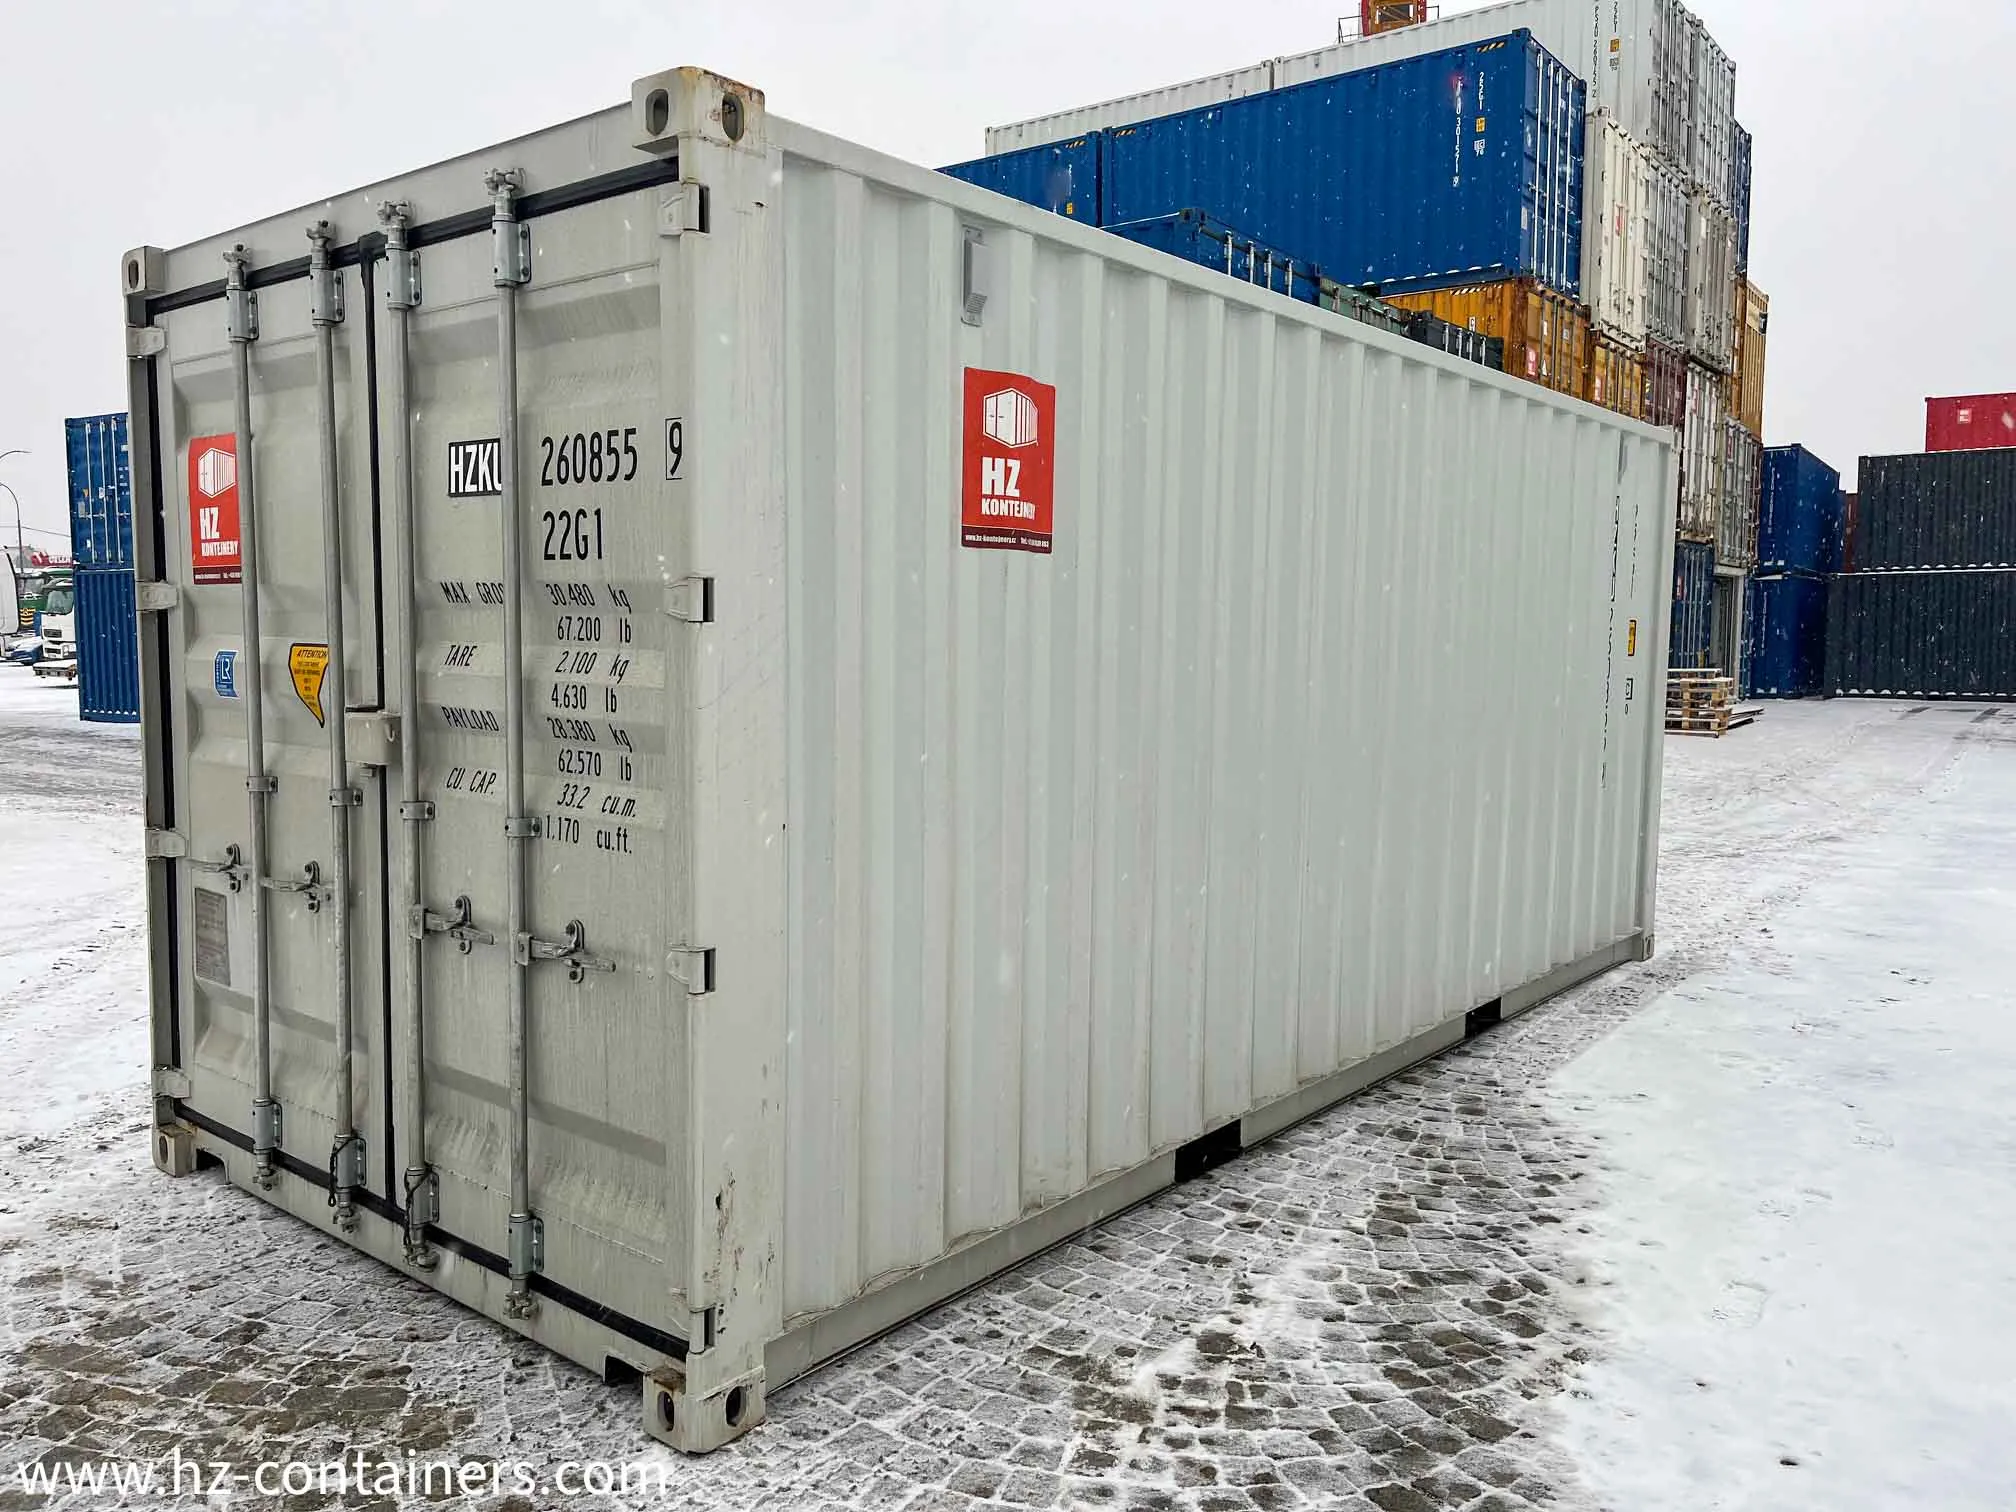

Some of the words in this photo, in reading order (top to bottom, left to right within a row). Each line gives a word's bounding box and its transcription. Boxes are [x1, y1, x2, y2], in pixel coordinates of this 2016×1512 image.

[541, 428, 638, 487] 260855
[669, 421, 683, 477] 9
[982, 456, 1021, 498] HZ
[199, 507, 220, 540] HZ
[543, 508, 603, 561] 22G1
[440, 582, 471, 604] MAX
[545, 583, 596, 607] 30.480
[608, 584, 632, 614] kg
[557, 616, 601, 642] 67.200
[619, 617, 632, 643] lb
[444, 645, 478, 667] TARE
[555, 651, 598, 675] 2.100
[609, 654, 630, 684] kg
[551, 683, 587, 710] 4.630
[605, 687, 617, 713] lb
[441, 706, 500, 732] PAYLOAD
[547, 717, 596, 742] 28.380
[609, 723, 633, 753] kg
[446, 767, 463, 790] CU.
[469, 771, 497, 795] CAP.
[558, 749, 601, 777] 62.570
[620, 756, 632, 781] lb
[557, 783, 591, 810] 33.2
[601, 795, 636, 818] cu.m.
[546, 815, 580, 844] 1.170
[596, 827, 633, 854] cu.ft.
